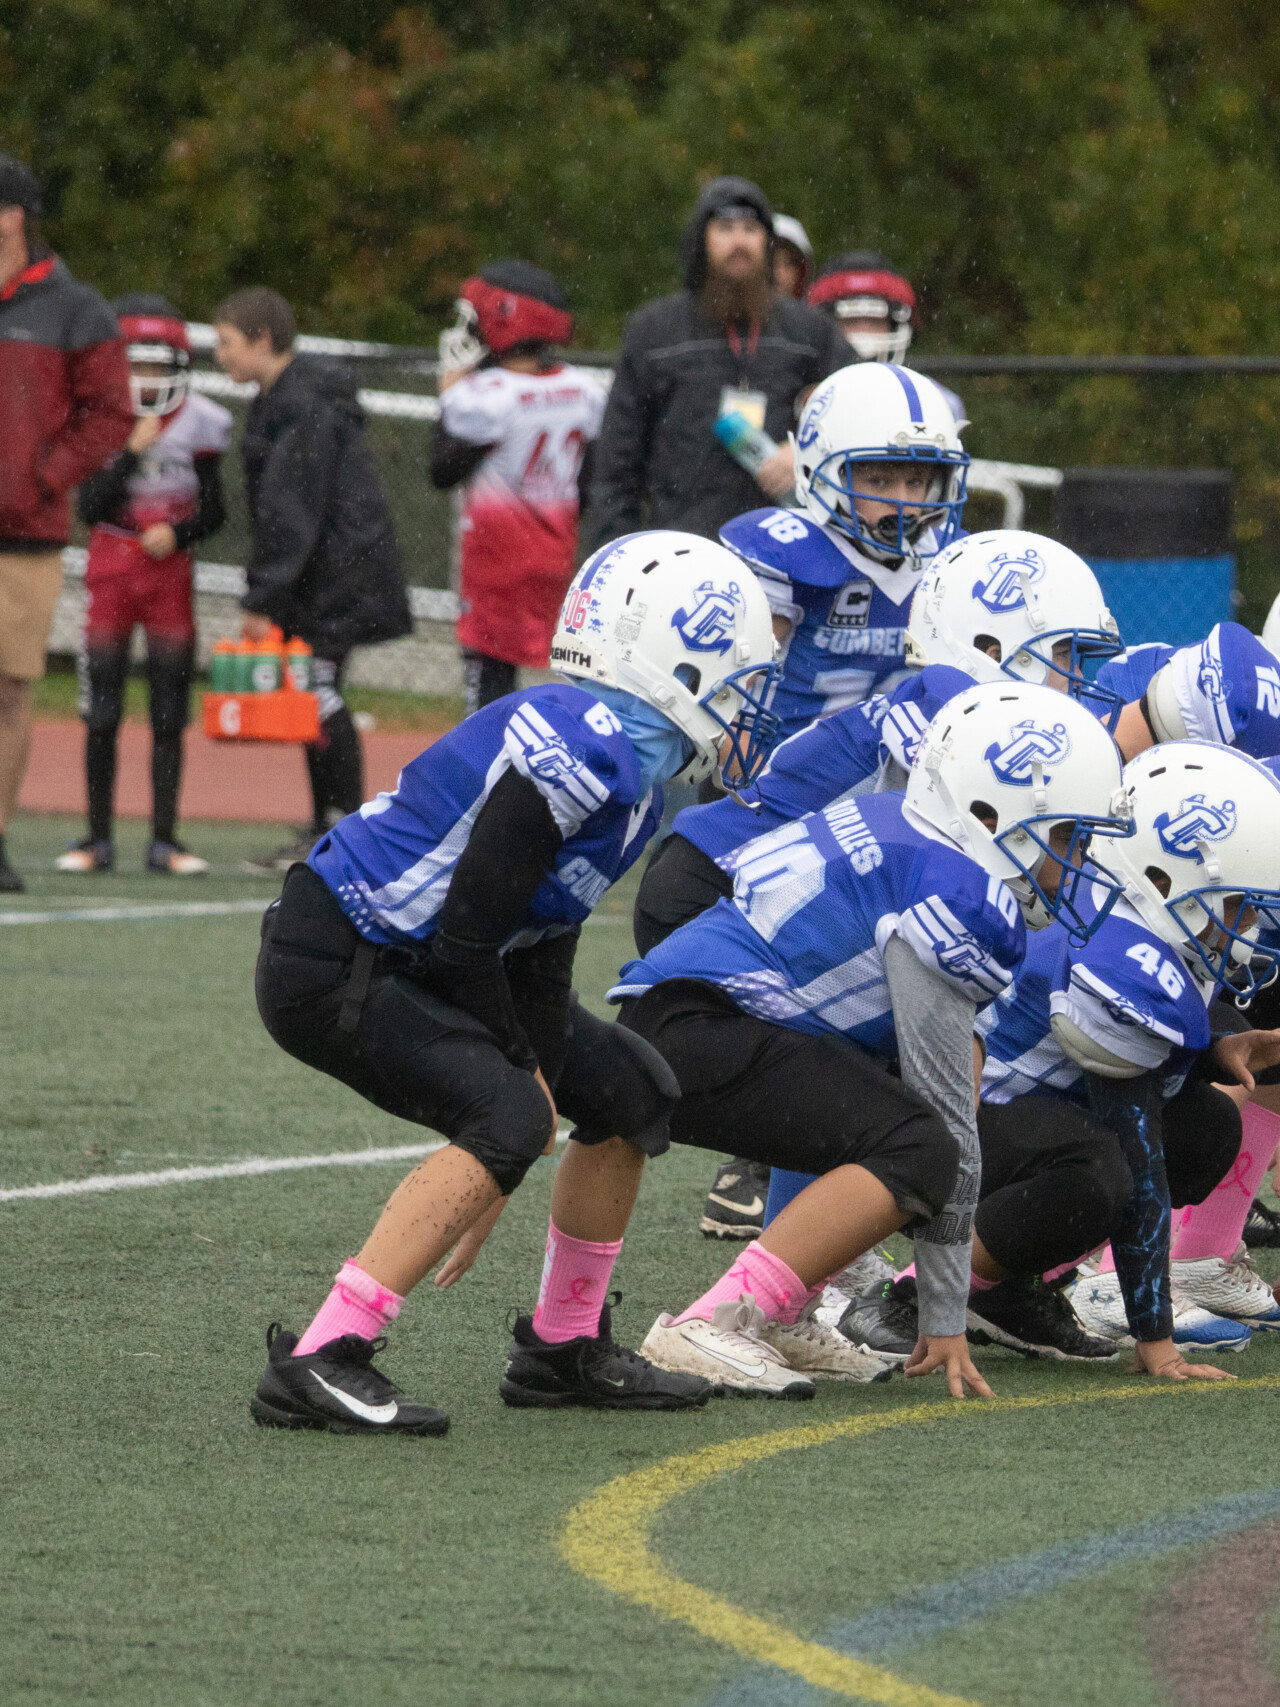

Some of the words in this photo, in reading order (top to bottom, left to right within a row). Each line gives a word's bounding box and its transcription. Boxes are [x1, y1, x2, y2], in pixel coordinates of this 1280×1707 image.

[757, 510, 809, 544] 18
[563, 589, 592, 630] 06
[834, 582, 872, 615] C
[584, 701, 622, 737] 6
[1125, 942, 1186, 1000] 46
